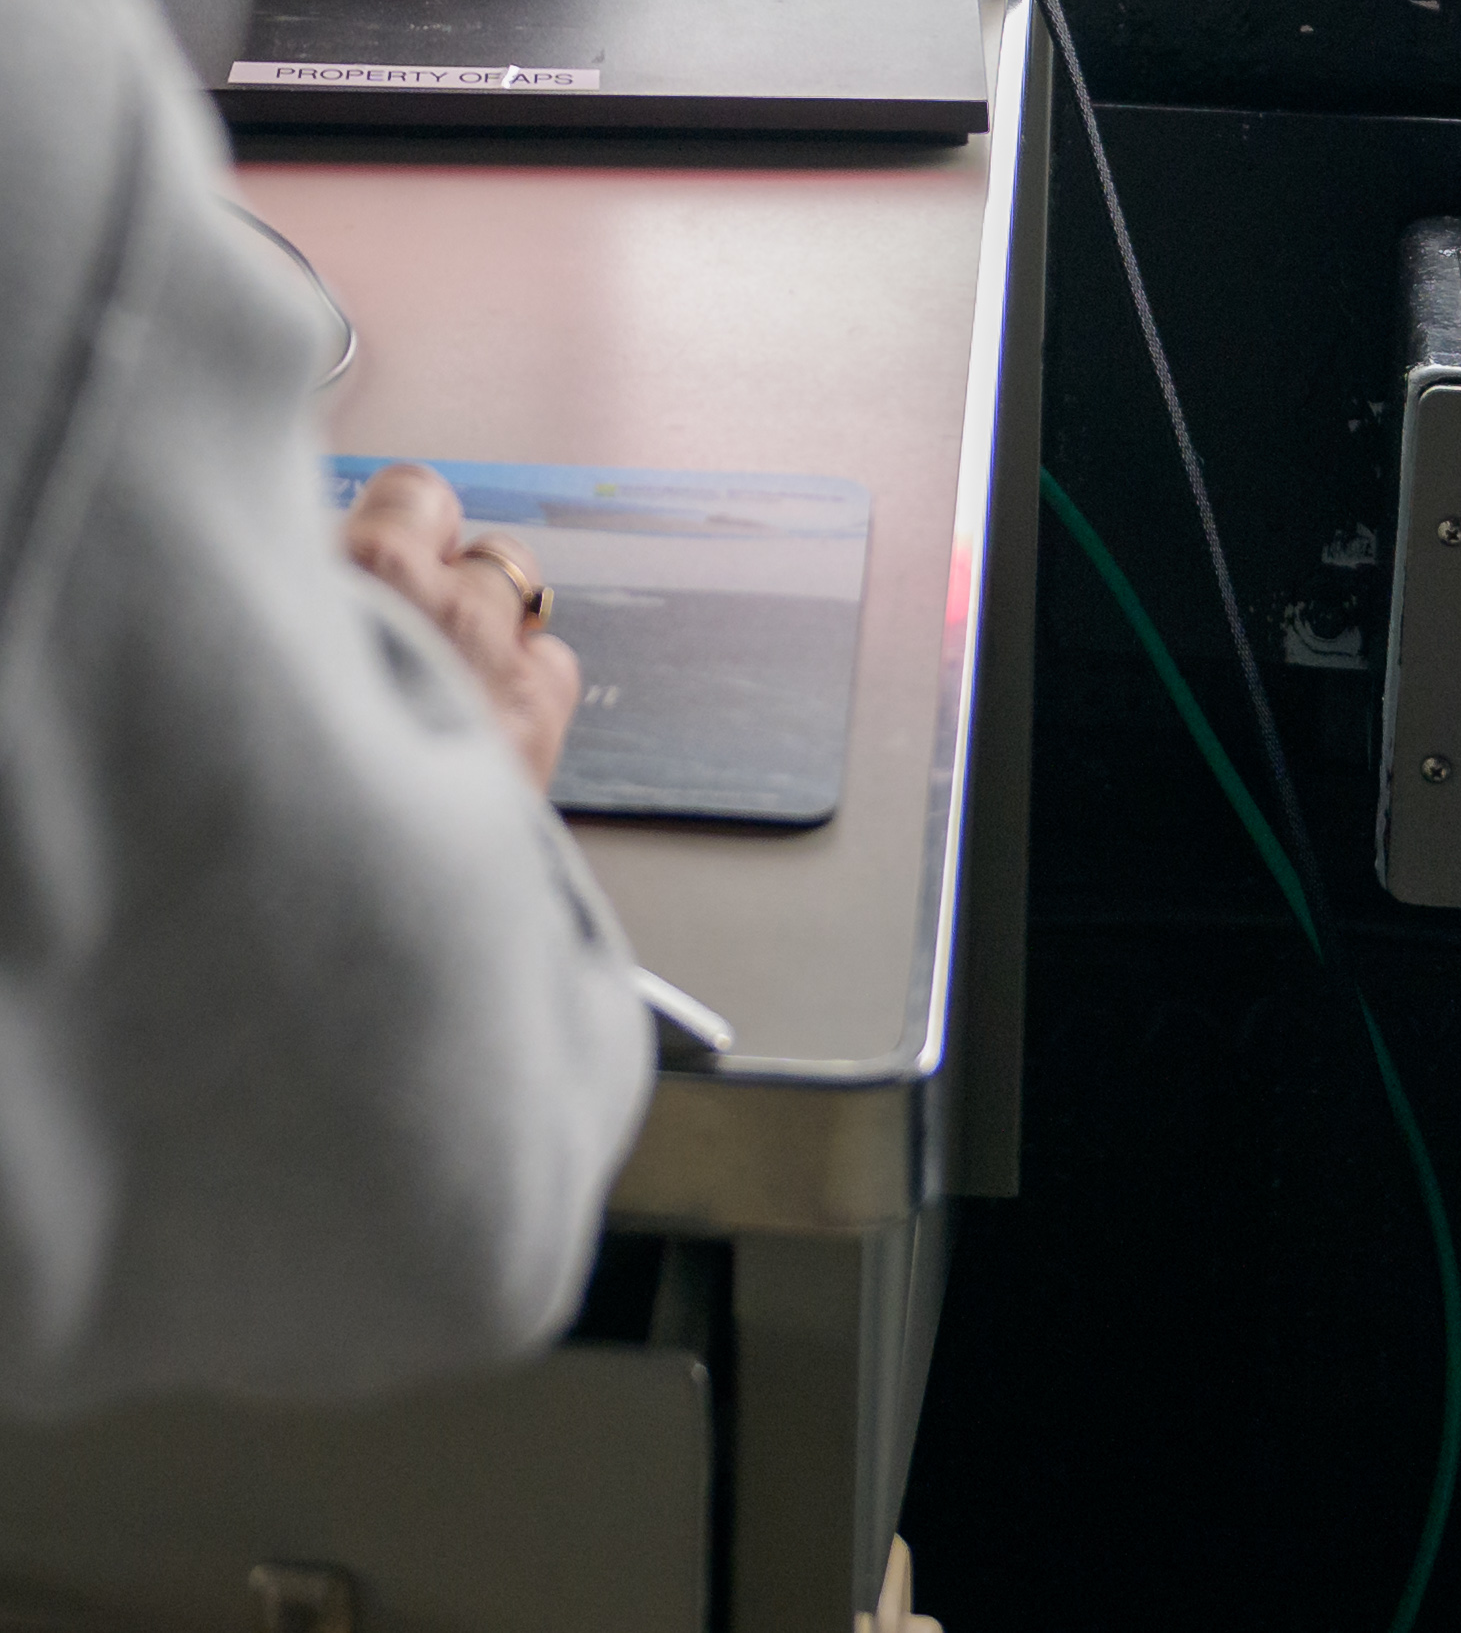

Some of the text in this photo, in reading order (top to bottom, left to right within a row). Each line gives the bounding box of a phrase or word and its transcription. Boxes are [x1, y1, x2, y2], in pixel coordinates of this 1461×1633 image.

[276, 67, 574, 85] PROPERTY OF APS
